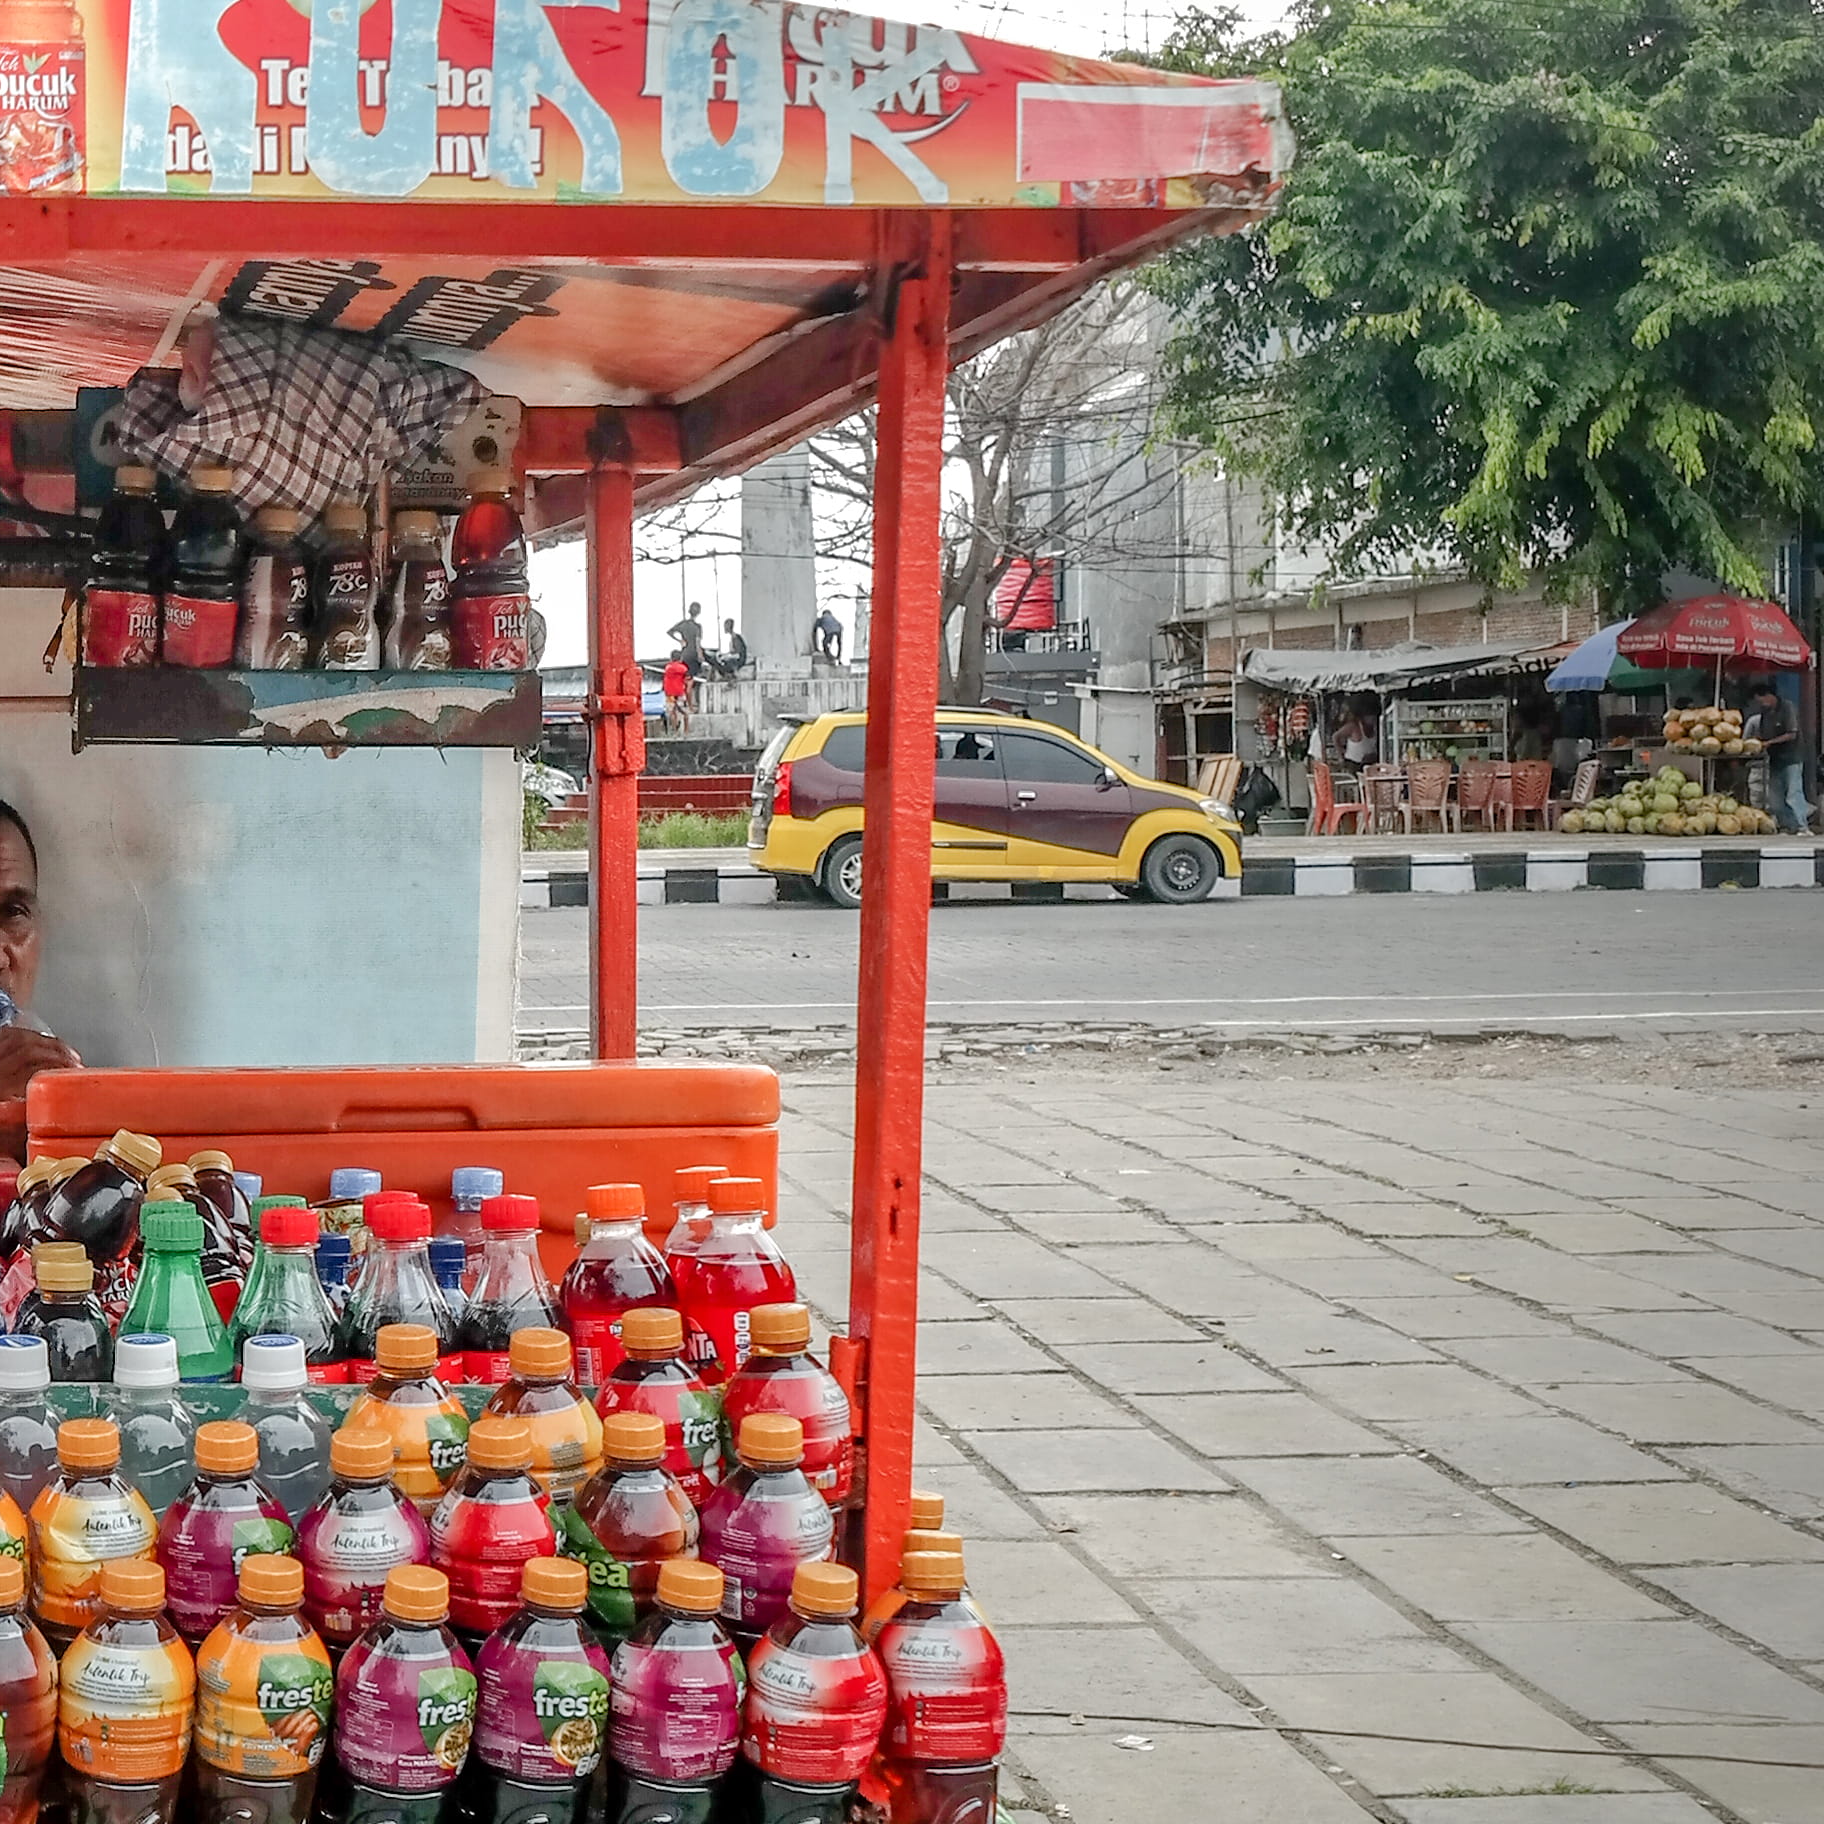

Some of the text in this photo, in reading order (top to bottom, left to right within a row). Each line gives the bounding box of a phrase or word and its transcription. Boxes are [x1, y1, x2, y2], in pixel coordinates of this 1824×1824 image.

[260, 59, 312, 107] Te
[2, 95, 71, 119] HARUM
[258, 1679, 333, 1709] freste
